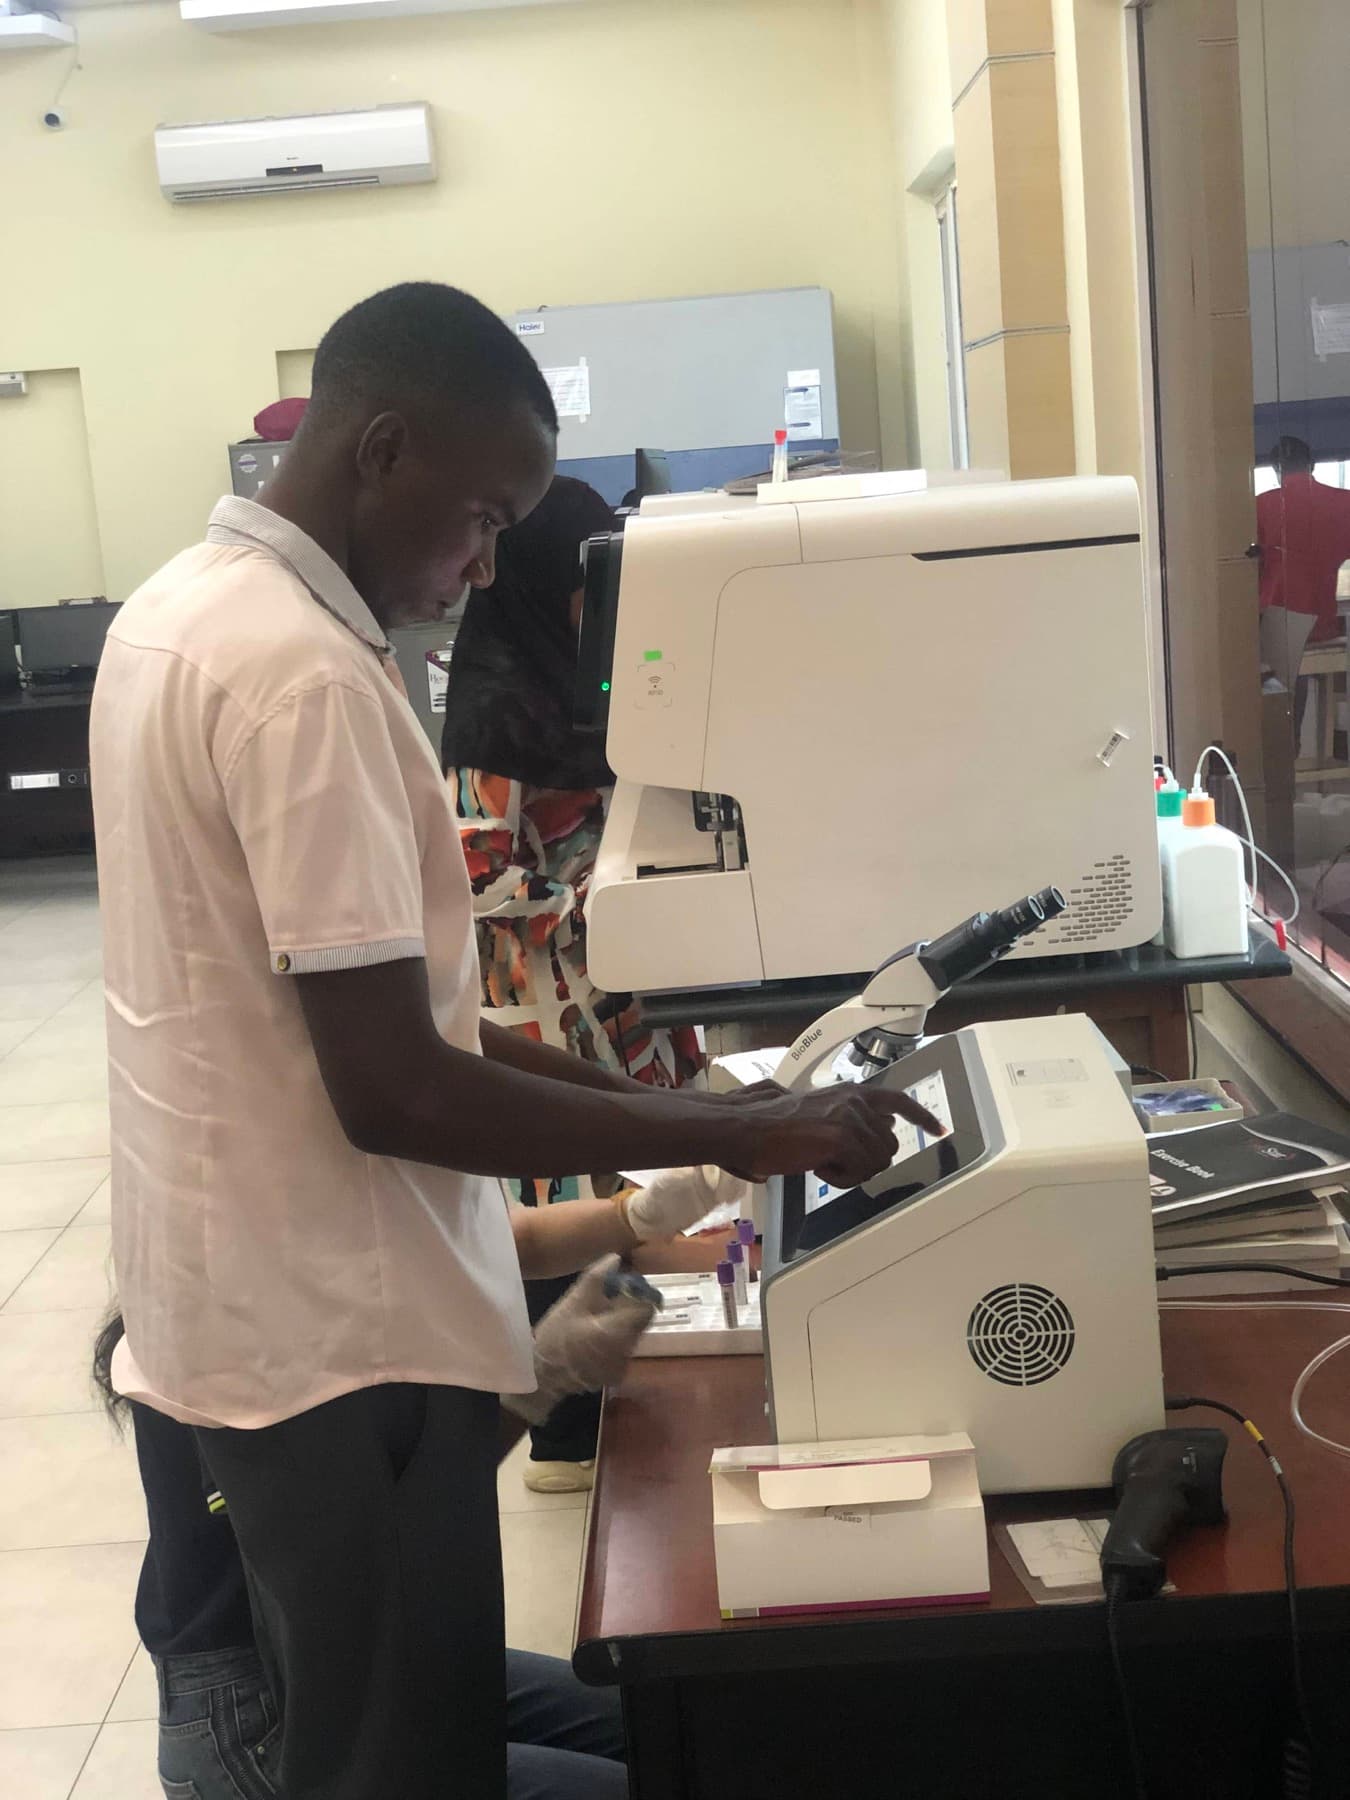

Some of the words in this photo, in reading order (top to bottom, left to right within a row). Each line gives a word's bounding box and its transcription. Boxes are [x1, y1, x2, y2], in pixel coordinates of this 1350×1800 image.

[519, 323, 541, 332] Haier
[791, 1028, 823, 1061] BioBlue
[1150, 1149, 1190, 1167] Exercise
[1185, 1165, 1215, 1178] Book
